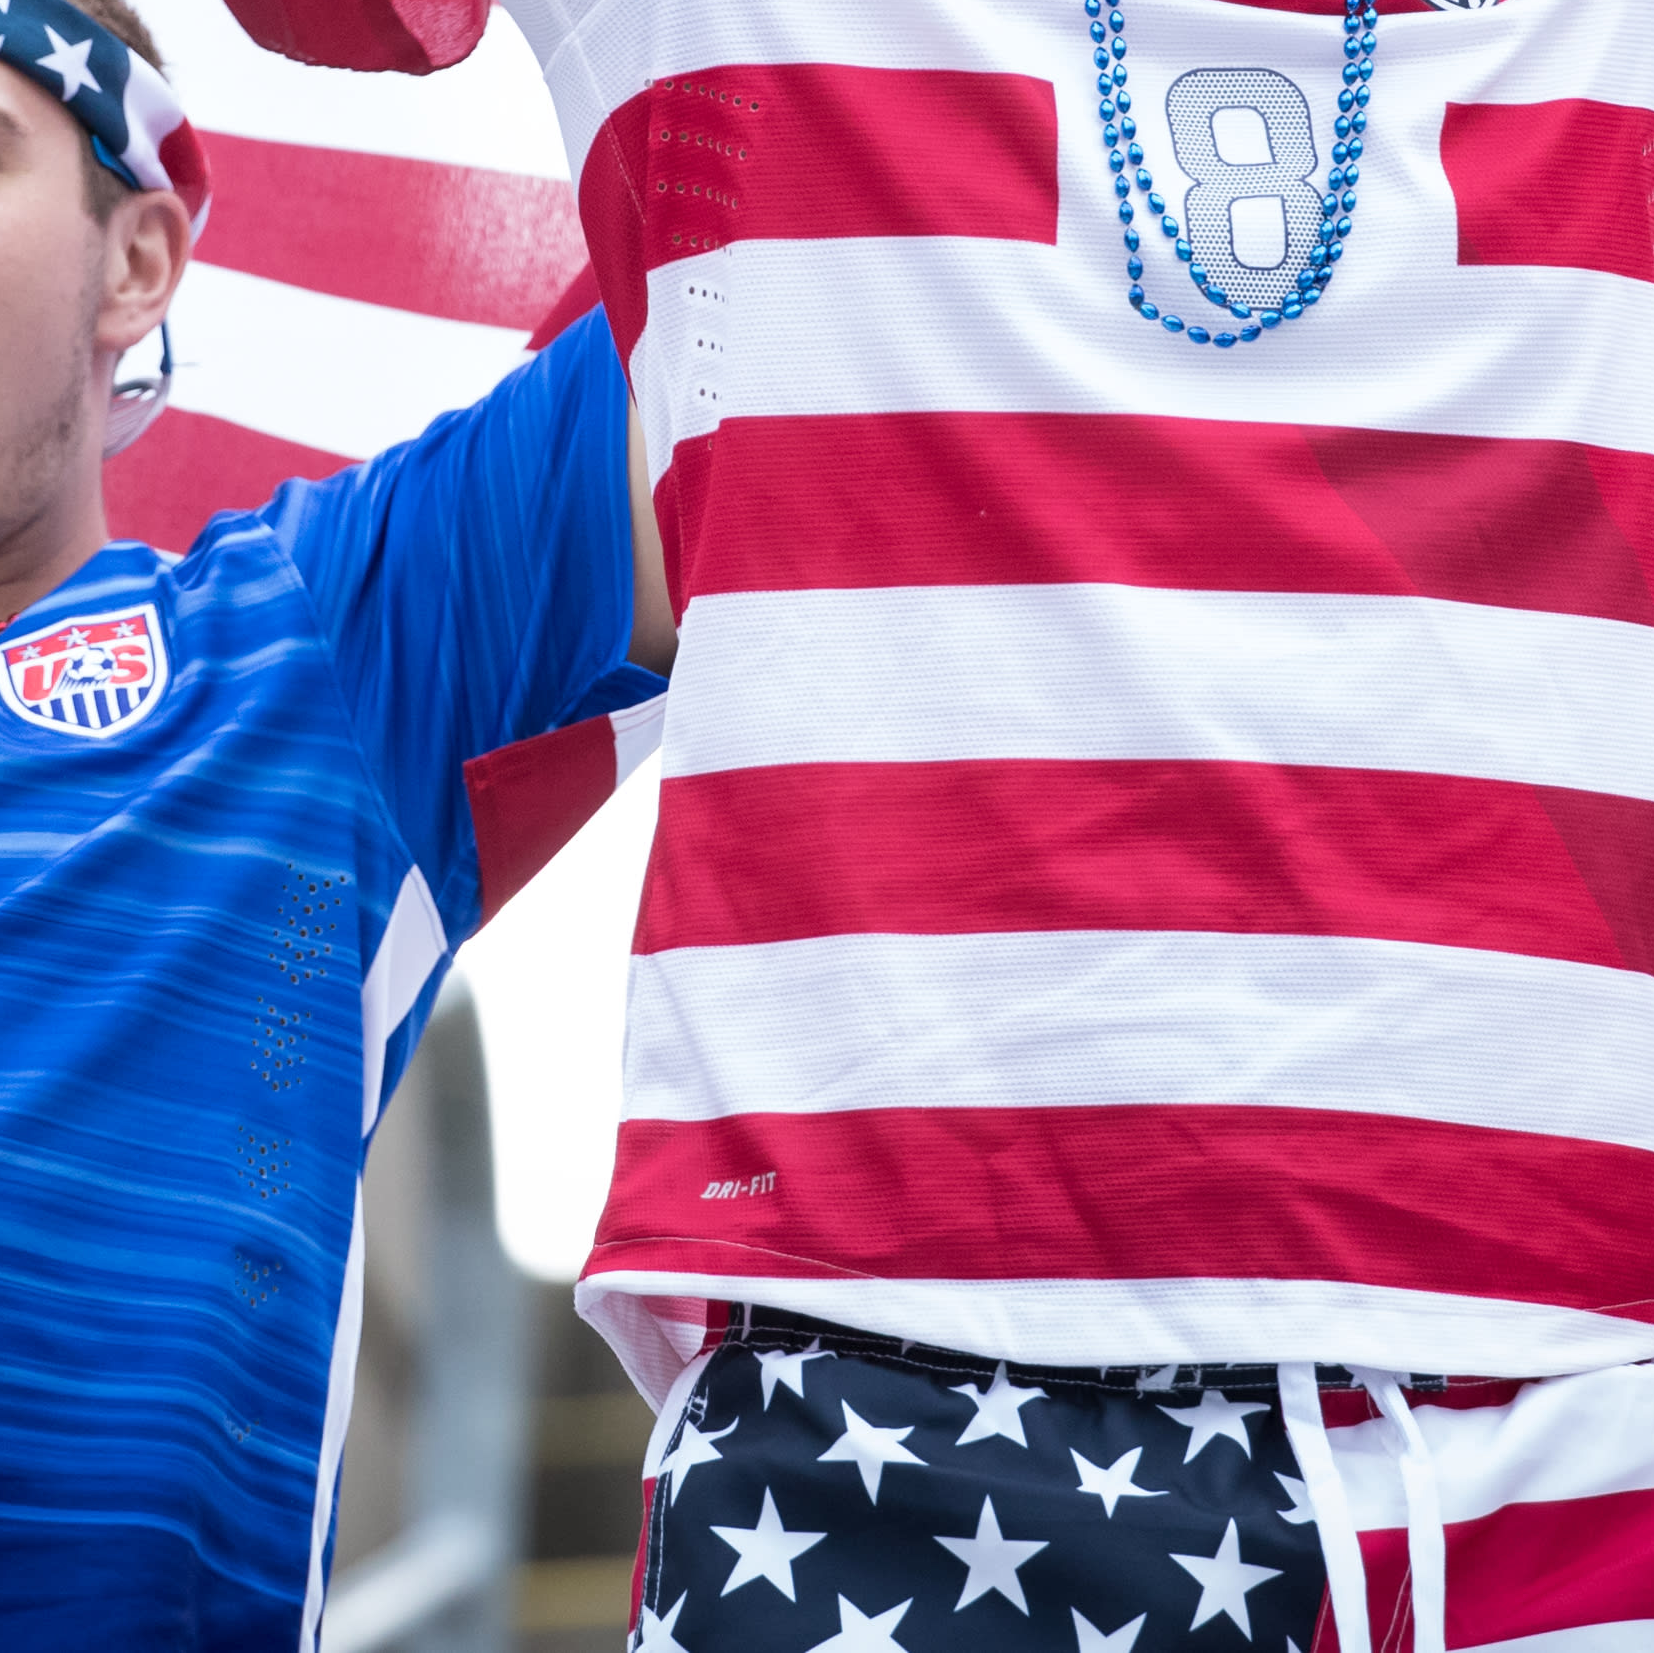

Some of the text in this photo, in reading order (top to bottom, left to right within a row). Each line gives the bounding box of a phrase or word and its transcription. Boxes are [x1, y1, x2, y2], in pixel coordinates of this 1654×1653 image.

[1165, 68, 1328, 312] 8
[23, 644, 148, 701] US
[700, 1171, 776, 1199] DRI-FIT
